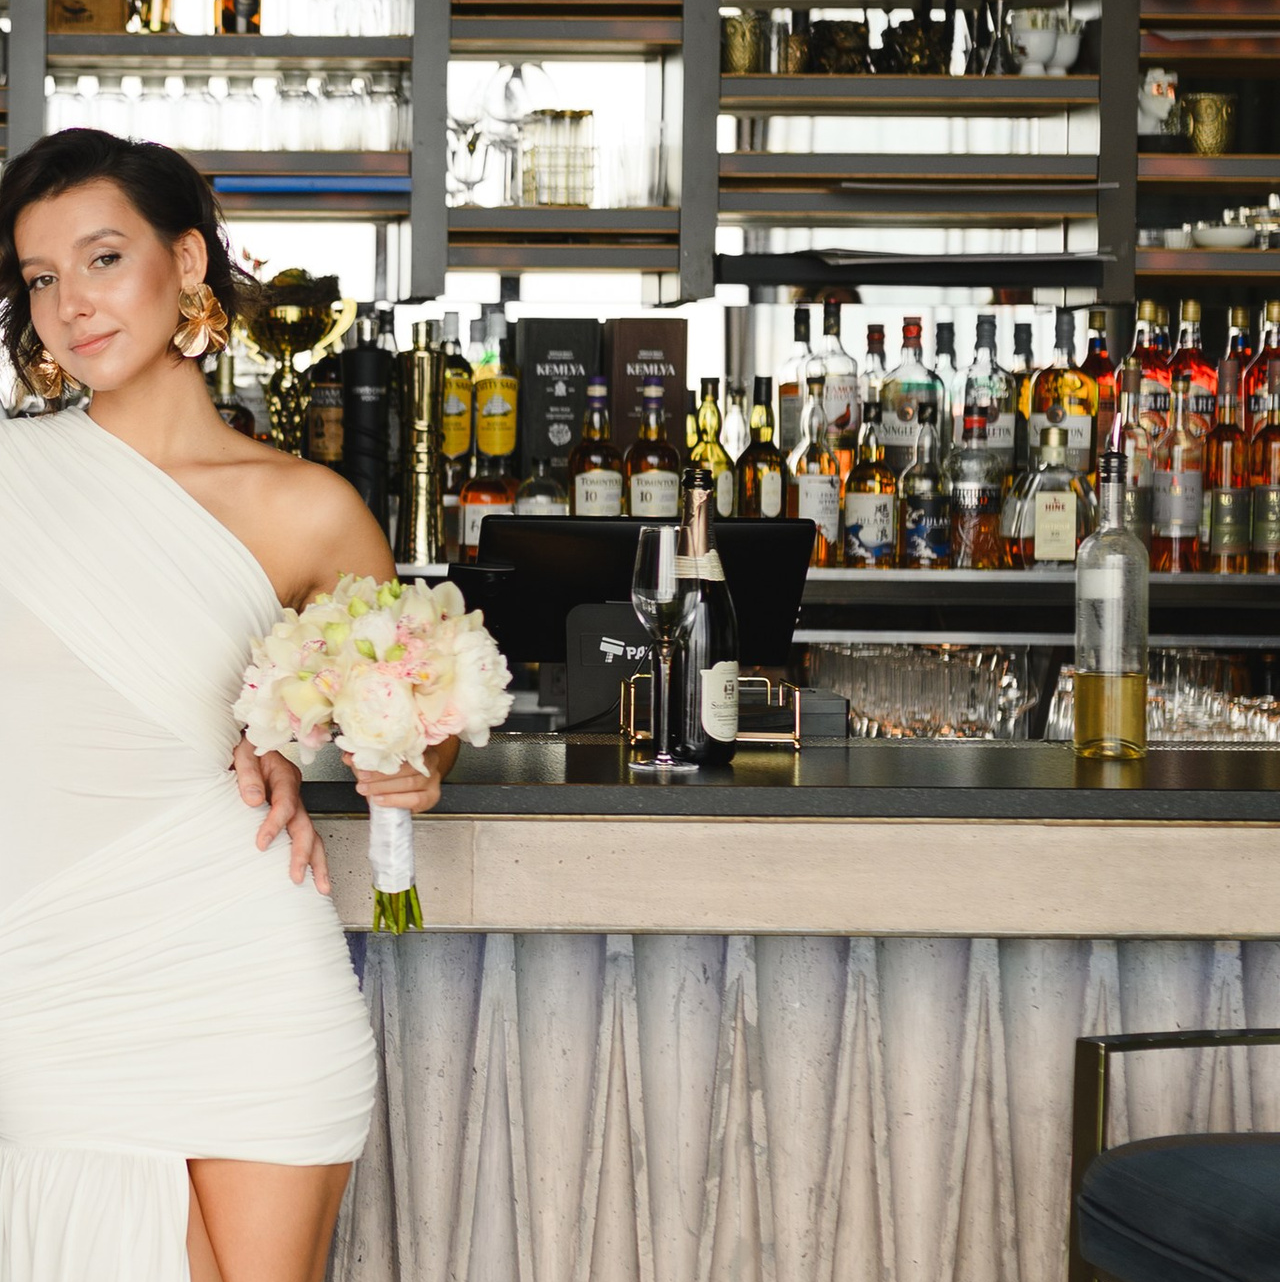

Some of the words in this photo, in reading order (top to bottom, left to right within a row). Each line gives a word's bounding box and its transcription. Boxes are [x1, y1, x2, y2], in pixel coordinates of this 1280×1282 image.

[882, 423, 916, 437] SINGLE
[986, 424, 1012, 437] LETON
[584, 490, 598, 503] 10
[639, 490, 653, 503] 10
